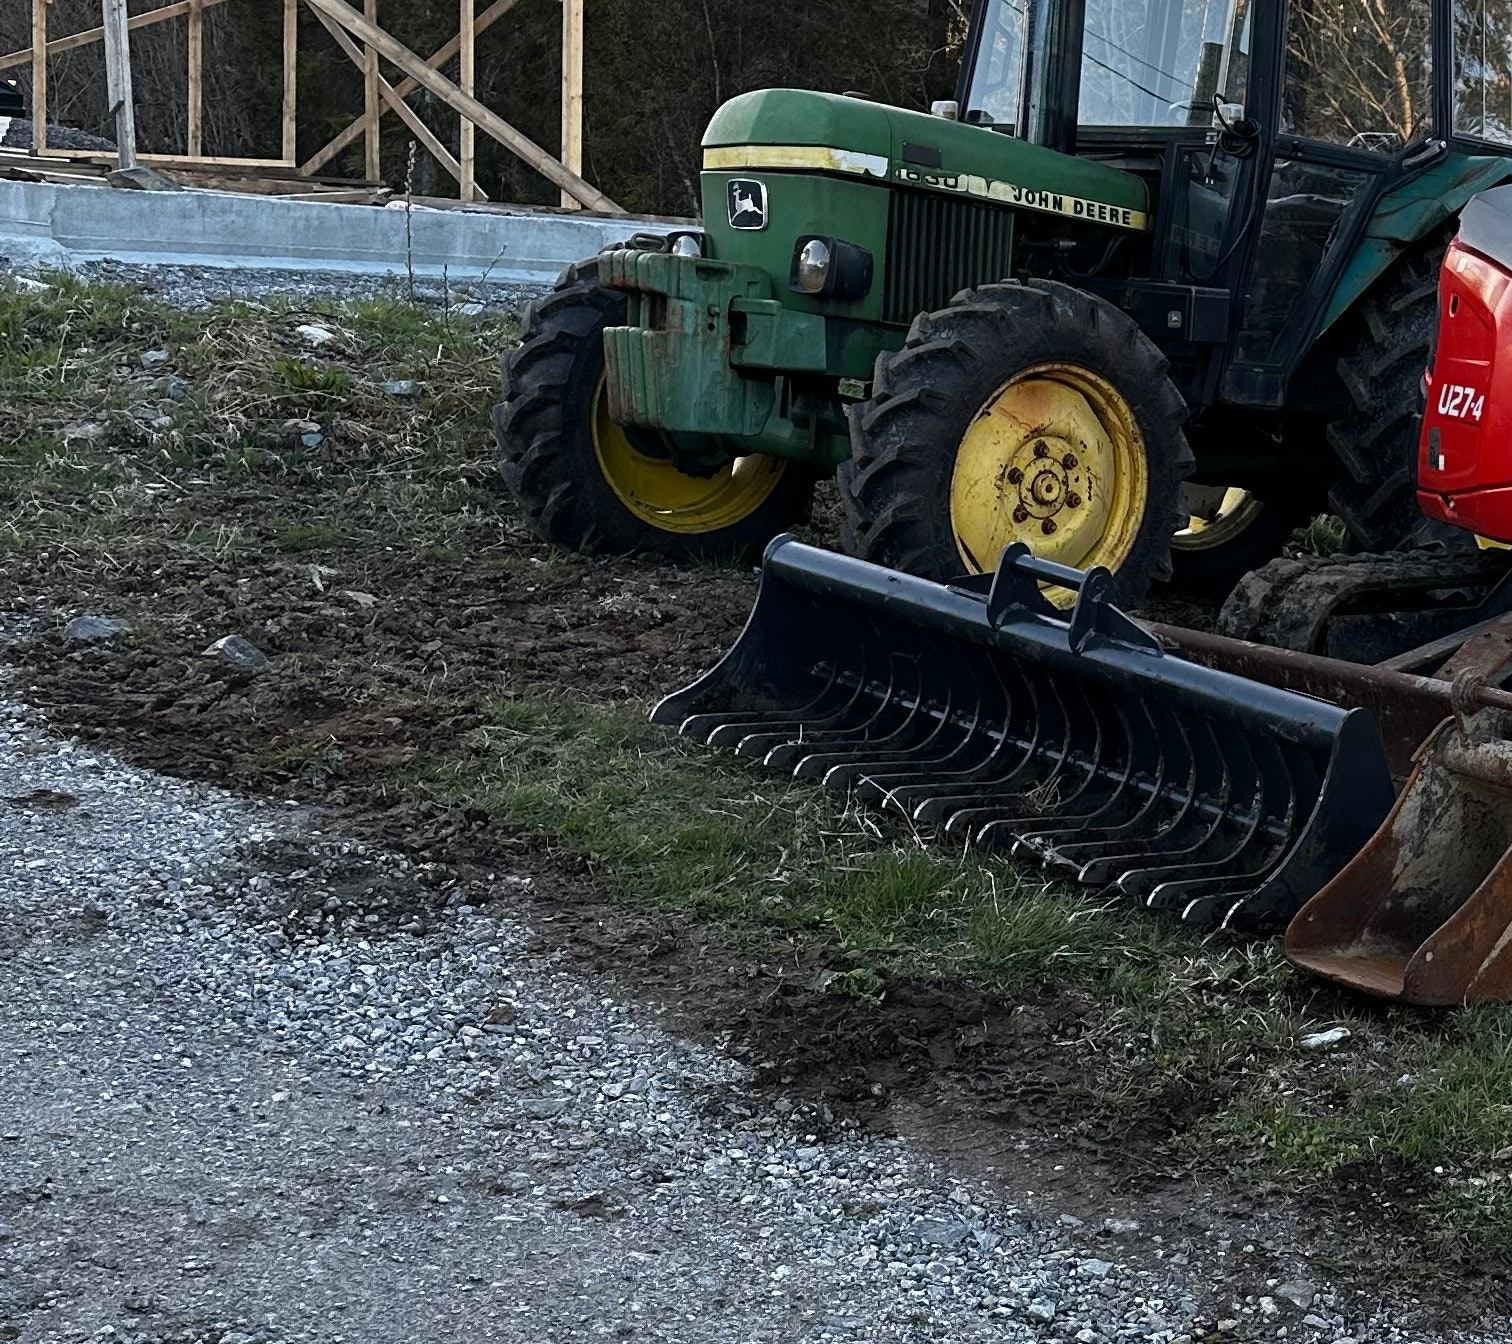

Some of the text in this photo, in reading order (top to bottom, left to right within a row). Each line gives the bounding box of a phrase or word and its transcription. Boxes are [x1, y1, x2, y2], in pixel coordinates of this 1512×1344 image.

[1011, 186, 1131, 226] JOHN DEERE
[1437, 383, 1485, 422] U27-4
